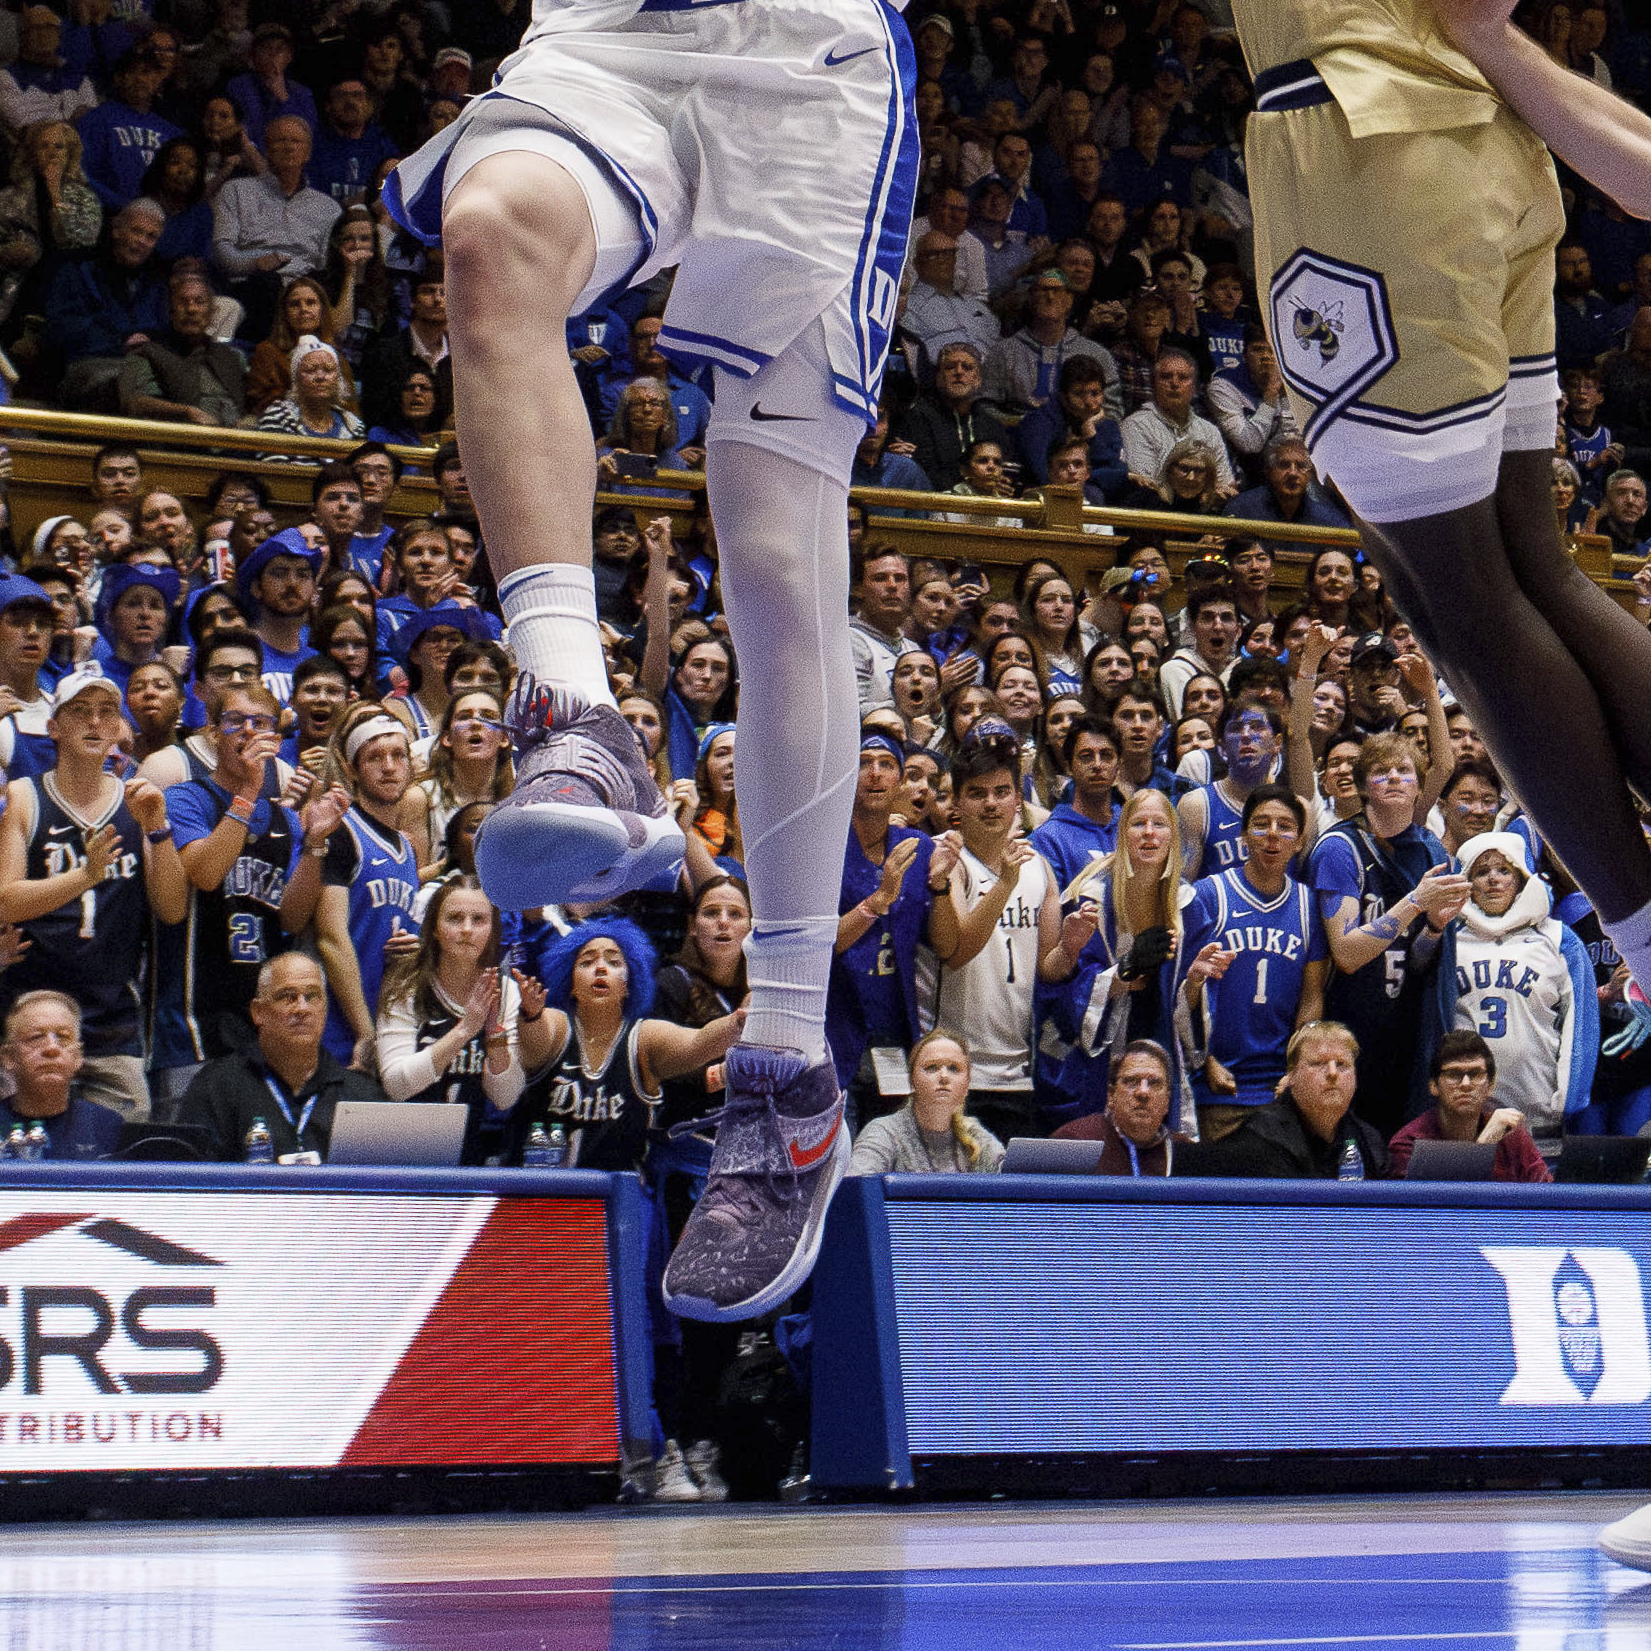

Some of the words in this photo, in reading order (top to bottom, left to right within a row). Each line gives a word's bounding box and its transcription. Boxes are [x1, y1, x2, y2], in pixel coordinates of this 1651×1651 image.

[78, 889, 97, 939] 1
[1004, 937, 1016, 984] 1
[1224, 926, 1305, 962] DUKE
[1253, 958, 1269, 1004] 1
[1384, 949, 1407, 998] 5
[1455, 960, 1540, 998] DUKE
[1479, 995, 1507, 1038] 3
[547, 1076, 625, 1121] Duke
